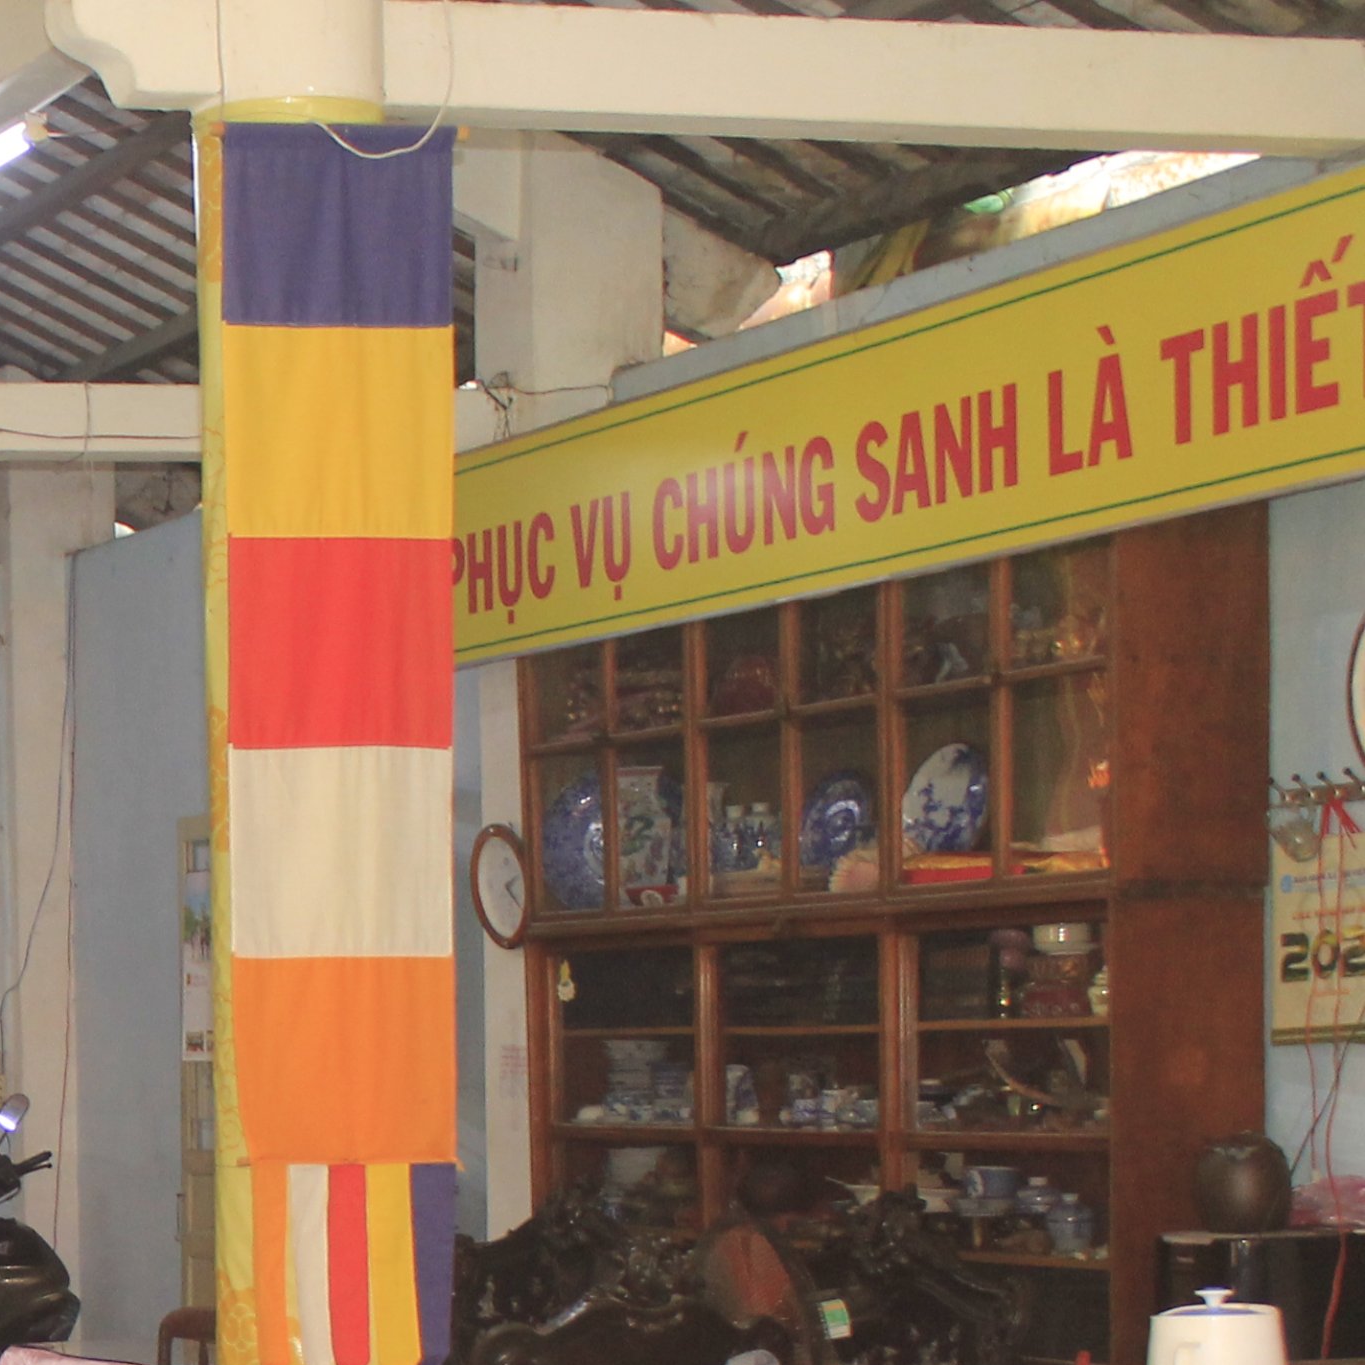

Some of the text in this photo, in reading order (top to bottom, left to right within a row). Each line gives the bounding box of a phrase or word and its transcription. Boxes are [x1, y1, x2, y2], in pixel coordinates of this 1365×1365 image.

[570, 490, 631, 601] VỤ
[652, 431, 835, 571] CHÚNG
[855, 383, 1018, 523] SANH
[1047, 325, 1133, 477] LÀ
